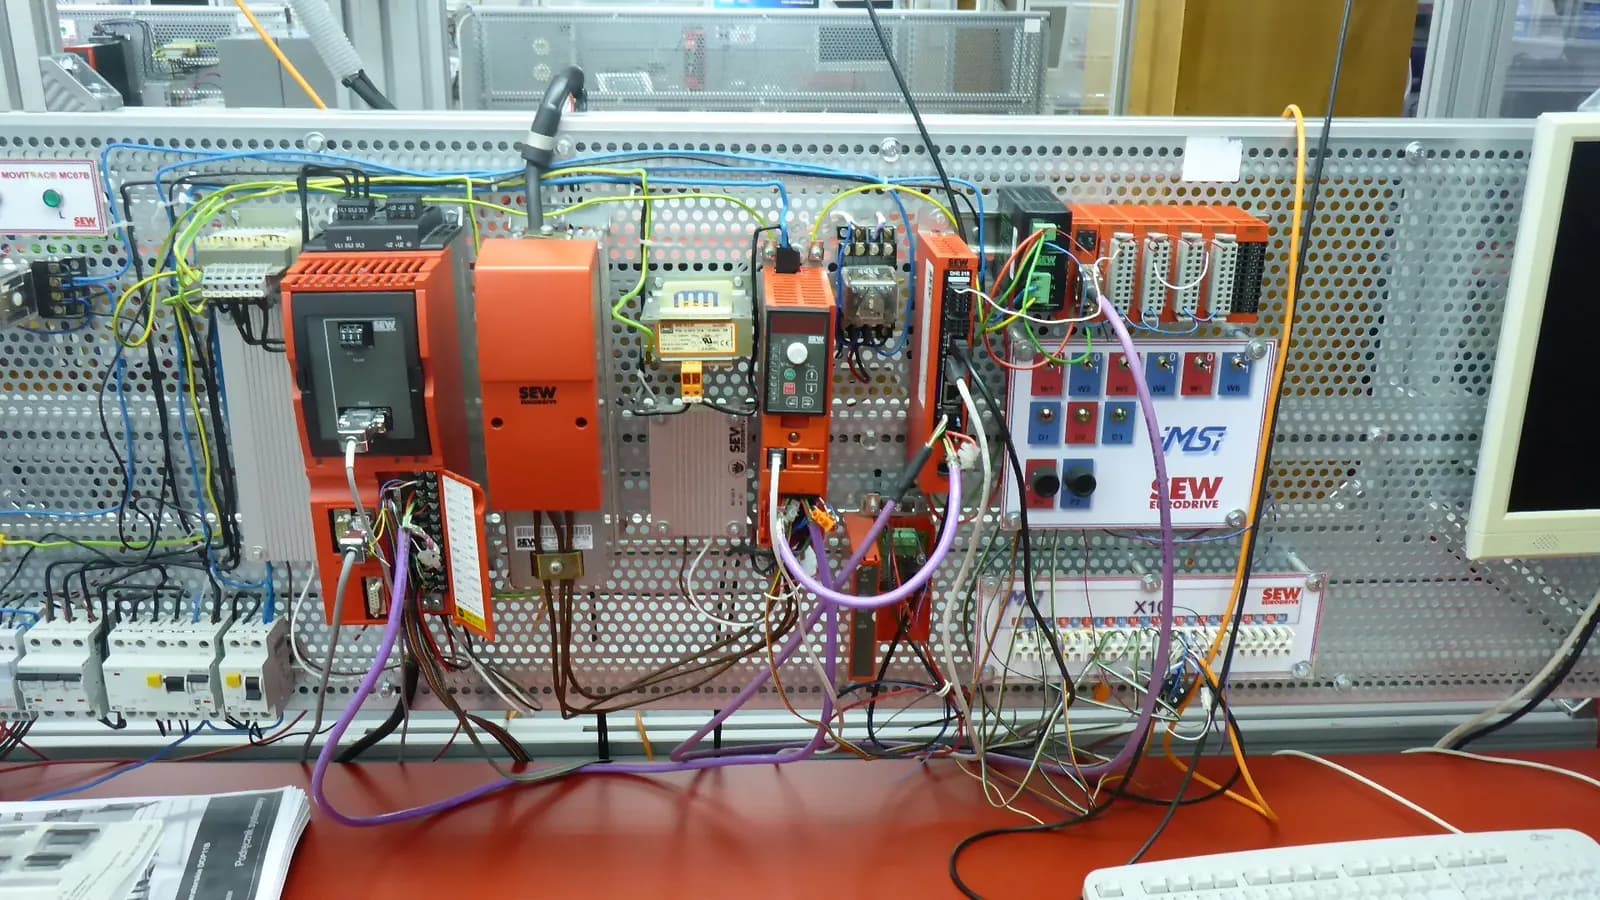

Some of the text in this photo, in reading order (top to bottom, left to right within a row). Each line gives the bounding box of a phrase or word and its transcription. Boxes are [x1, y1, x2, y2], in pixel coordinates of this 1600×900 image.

[74, 217, 96, 225] SEW
[373, 320, 396, 329] SEW
[519, 386, 557, 399] SEW
[1263, 588, 1302, 600] SEW
